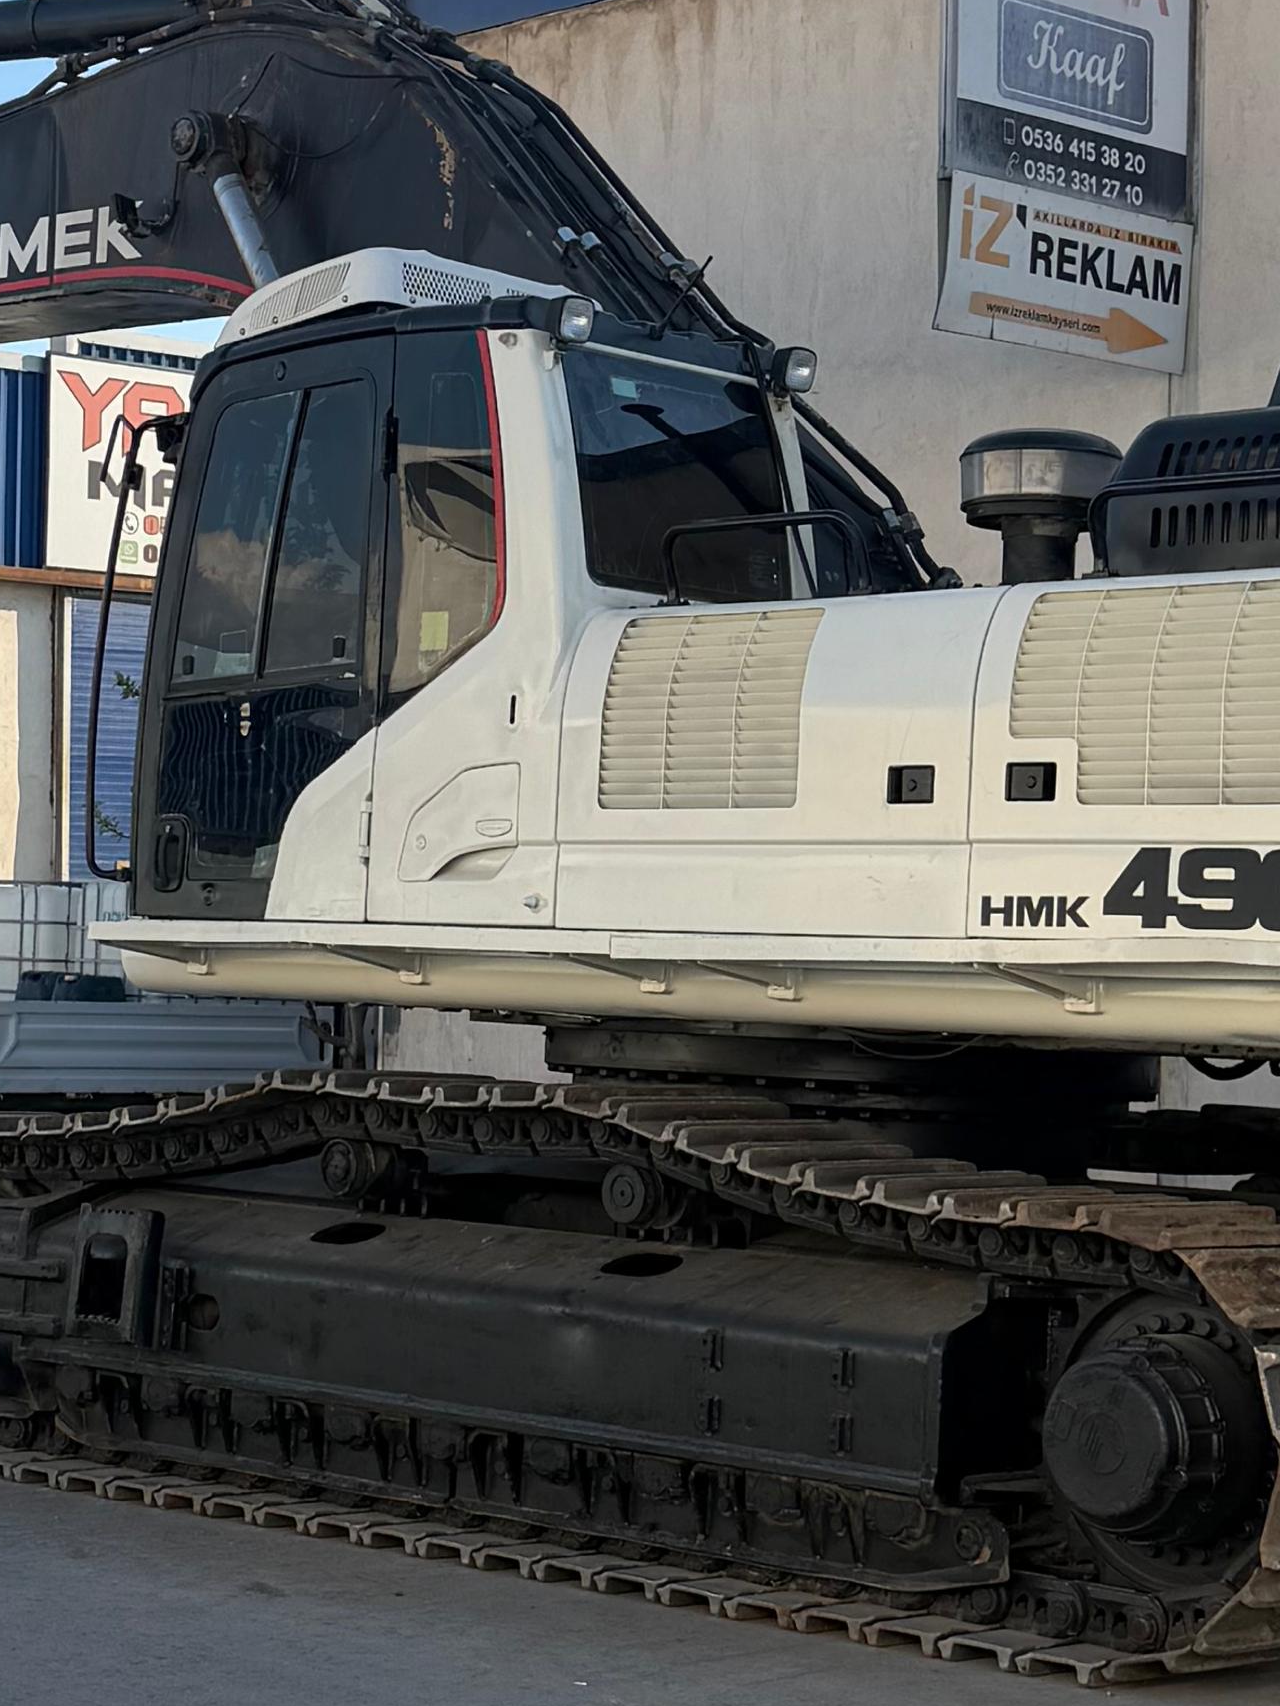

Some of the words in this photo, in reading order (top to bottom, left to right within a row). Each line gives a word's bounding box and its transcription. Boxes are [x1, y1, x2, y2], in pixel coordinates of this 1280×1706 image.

[1027, 20, 1126, 105] Kaaf
[1021, 125, 1064, 154] 0536
[1069, 138, 1096, 162] 415
[1100, 145, 1120, 168] 38
[1124, 151, 1146, 175] 20
[1024, 159, 1066, 187] 0352
[1071, 169, 1097, 194] 331
[1102, 178, 1121, 200] 27
[1125, 184, 1143, 206] 10
[1032, 210, 1102, 236] AKILLARDA
[1029, 231, 1182, 305] REKLAM
[980, 896, 1089, 928] HMK
